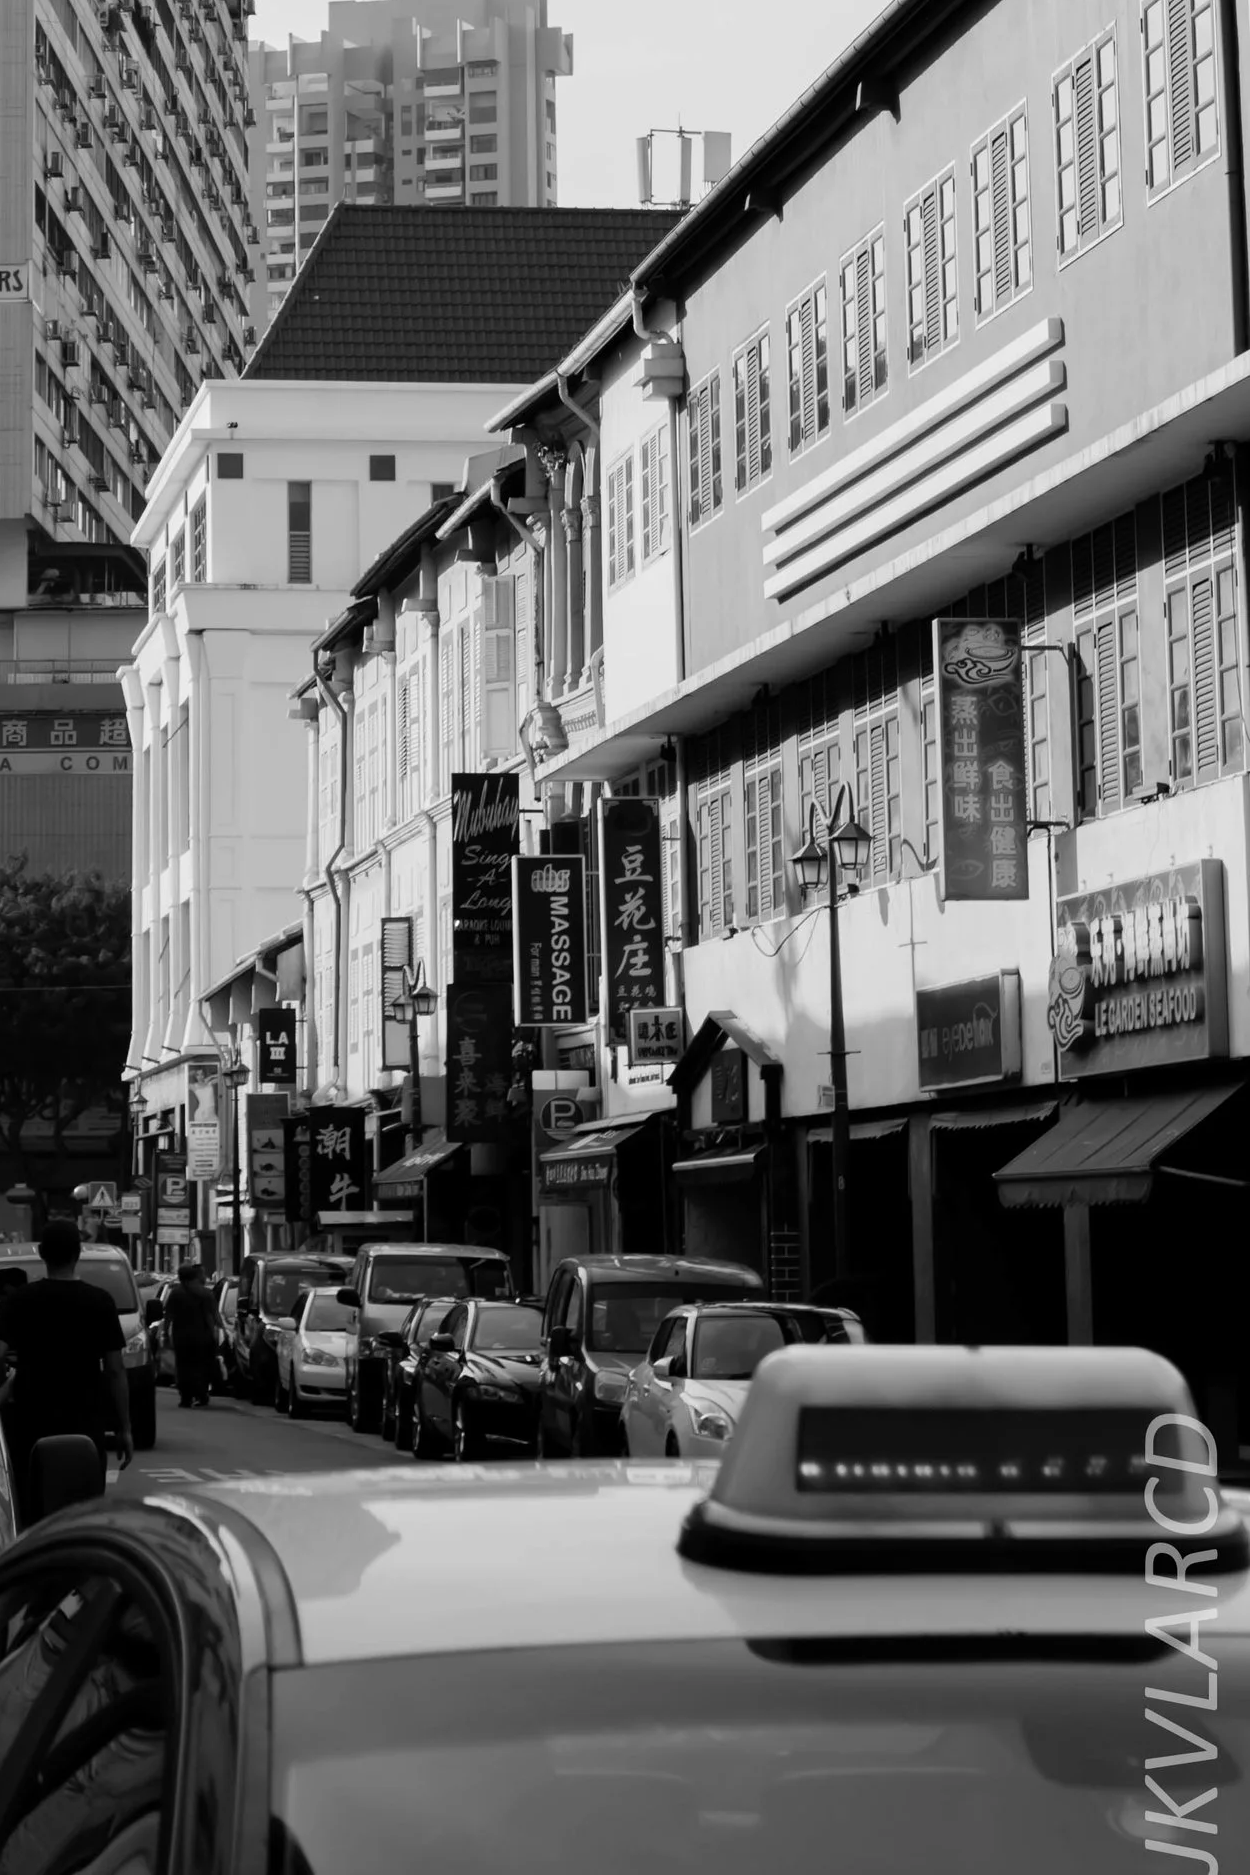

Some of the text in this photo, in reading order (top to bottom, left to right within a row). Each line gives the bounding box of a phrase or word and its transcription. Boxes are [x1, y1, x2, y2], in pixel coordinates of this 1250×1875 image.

[549, 895, 572, 1021] MASSAGE
[614, 845, 657, 979] 豆花庄
[1108, 994, 1148, 1034] GARDEN
[1148, 986, 1197, 1028] SEAFOOD
